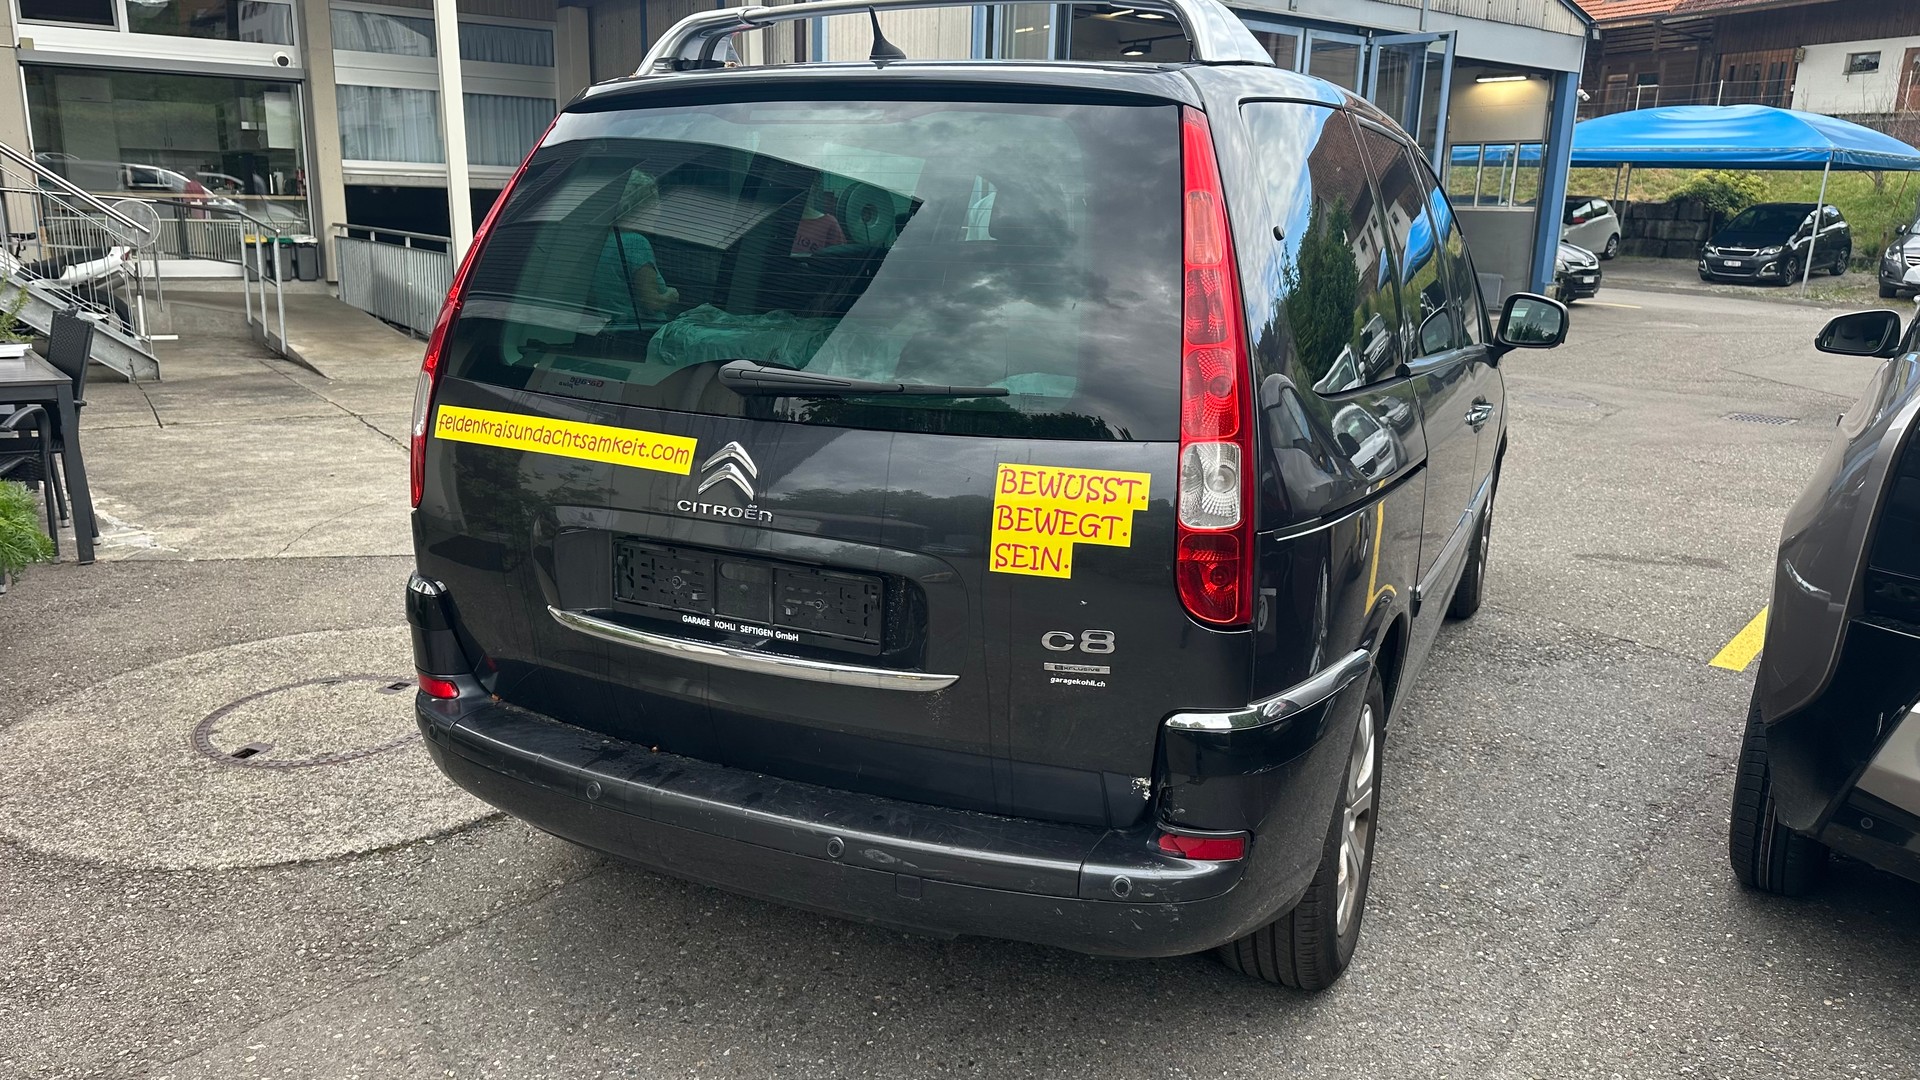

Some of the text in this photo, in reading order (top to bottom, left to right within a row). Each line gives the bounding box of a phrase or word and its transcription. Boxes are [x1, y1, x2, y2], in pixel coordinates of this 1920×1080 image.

[438, 413, 690, 466] feldenkraisundachtsamkeit.com
[1000, 468, 1147, 504] BEWUSST.
[676, 499, 773, 523] CITROËN
[996, 505, 1128, 540] BEWEGT.
[995, 543, 1069, 572] SEIN.
[681, 614, 799, 642] GARAGE KOHLI SEFTIGEN GmbH
[1041, 629, 1116, 654] C8
